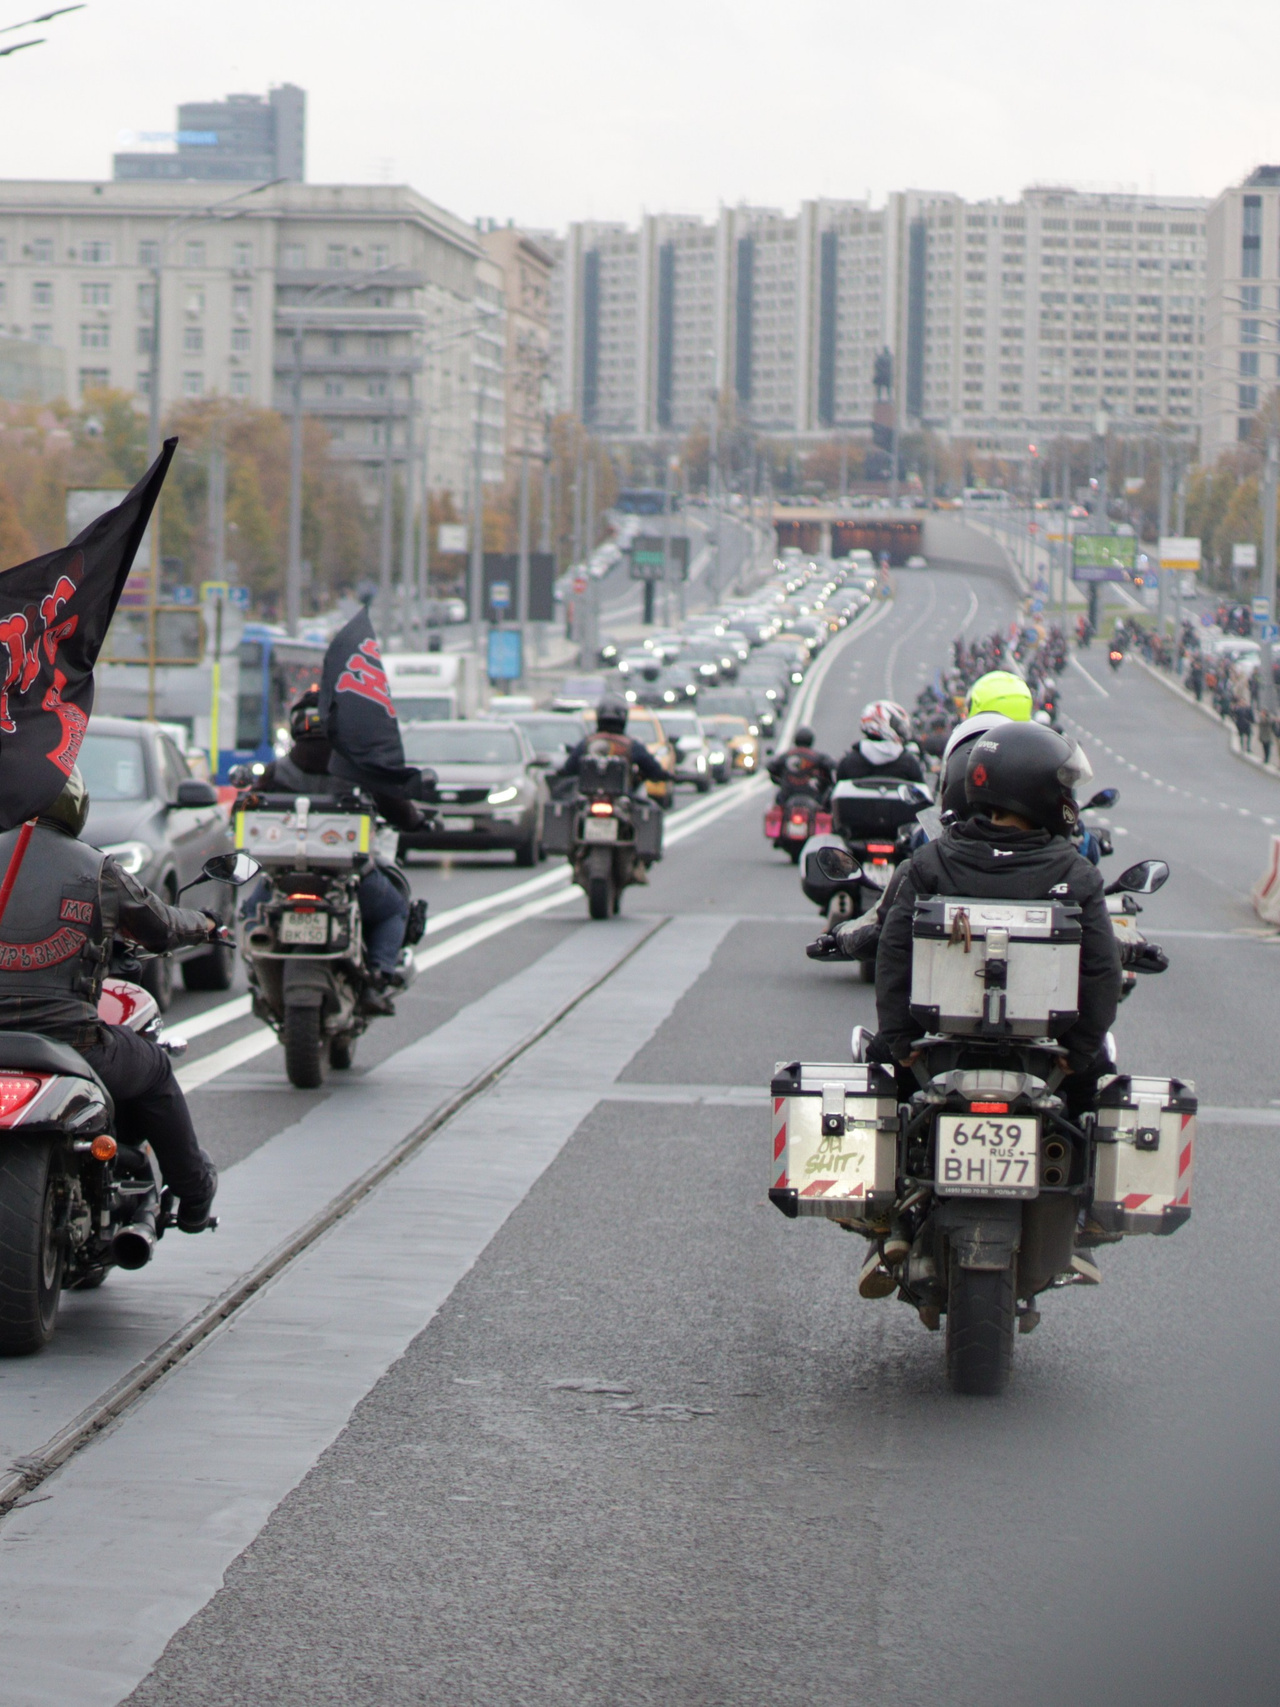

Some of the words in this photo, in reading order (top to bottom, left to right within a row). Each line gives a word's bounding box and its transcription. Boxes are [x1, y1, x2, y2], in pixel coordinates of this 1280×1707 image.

[953, 1122, 1022, 1147] 6439
[989, 1148, 1015, 1157] RUS
[996, 1159, 1029, 1182] 77
